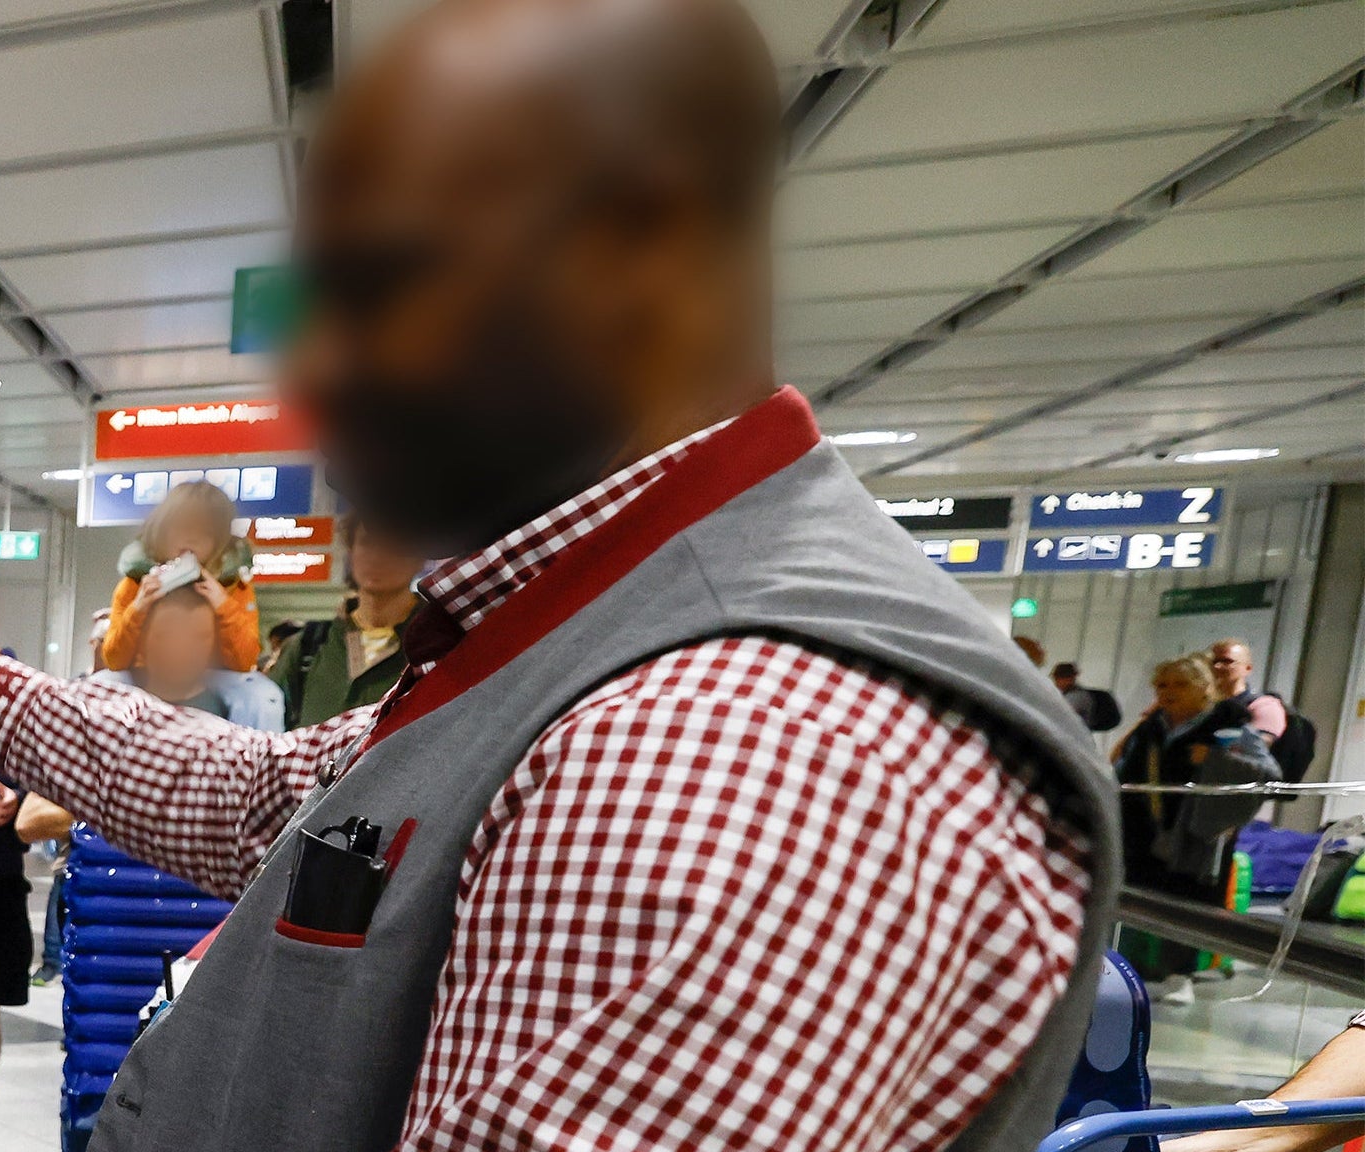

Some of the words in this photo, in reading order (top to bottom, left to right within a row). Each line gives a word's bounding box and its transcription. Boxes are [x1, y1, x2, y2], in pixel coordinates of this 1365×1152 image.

[938, 497, 955, 516] 2
[1066, 492, 1143, 511] Check-in
[1178, 487, 1214, 523] Z
[1126, 532, 1206, 569] B-E
